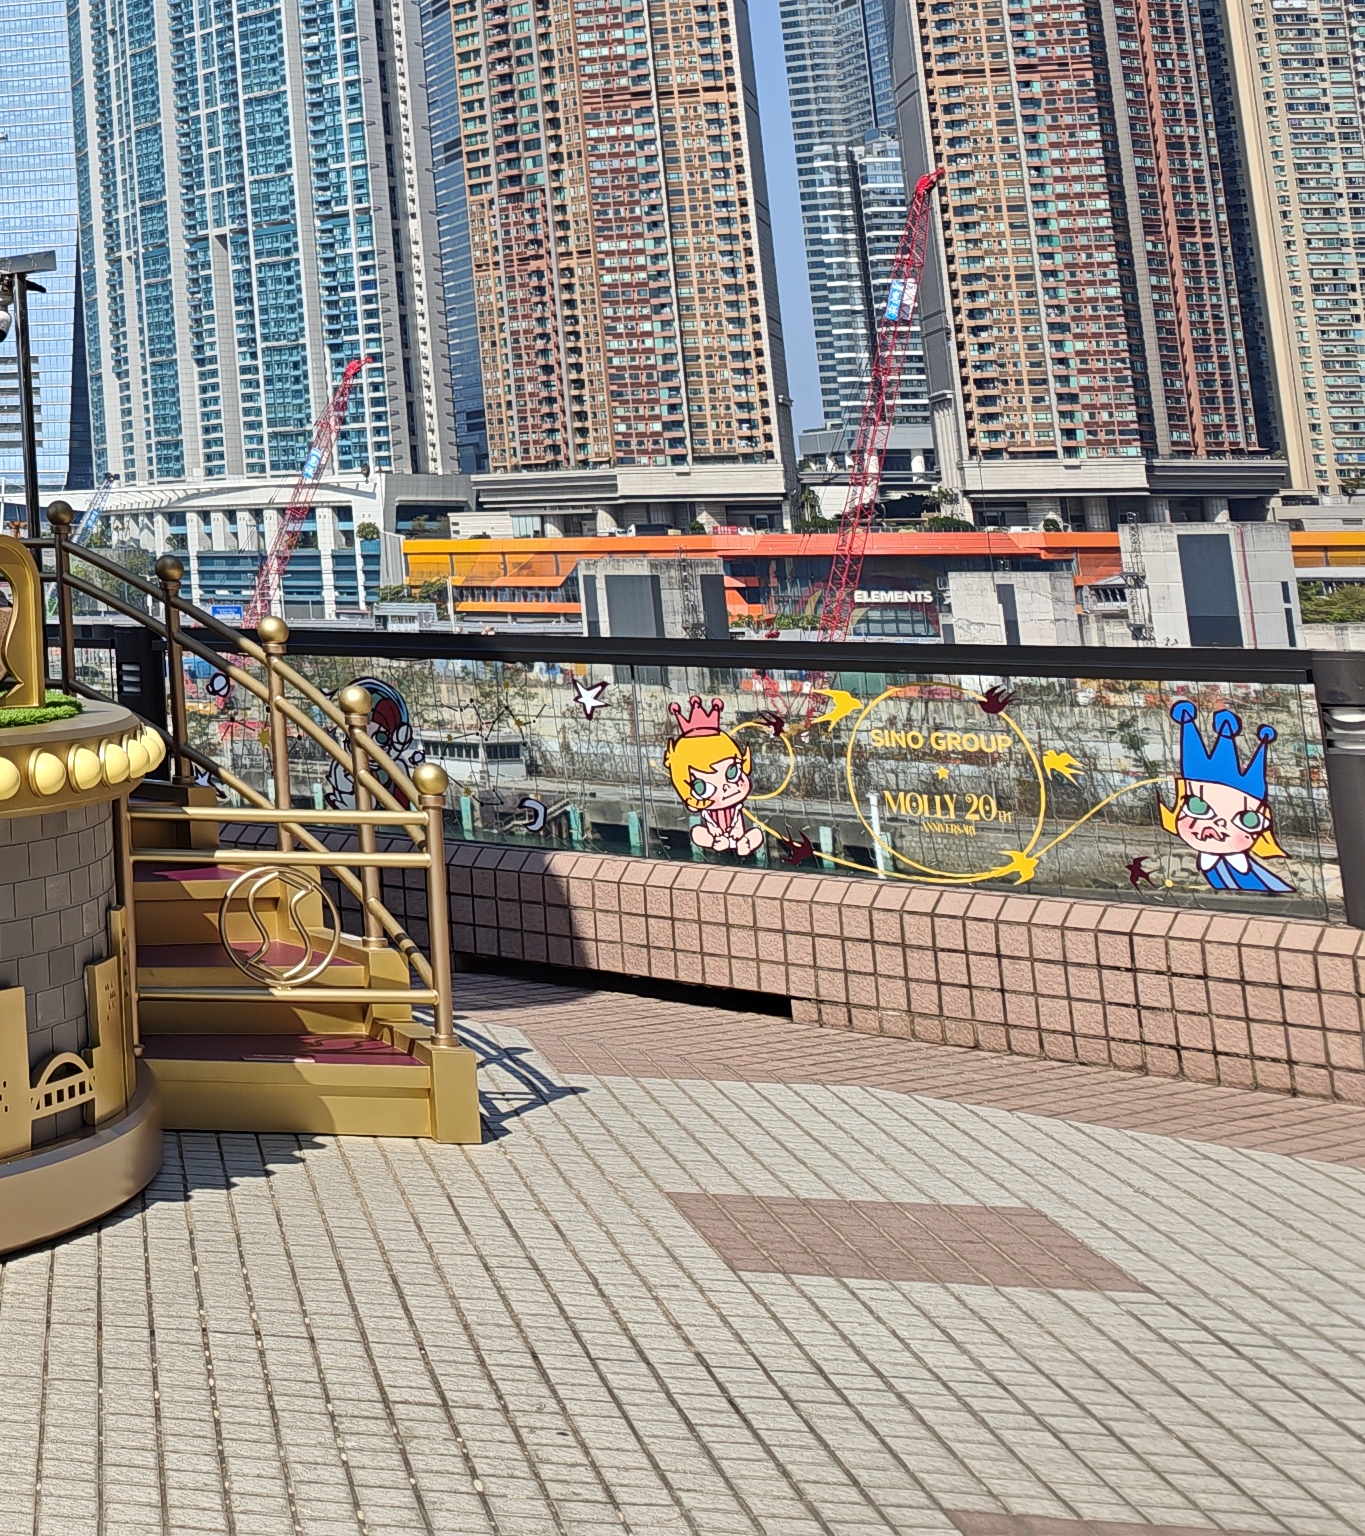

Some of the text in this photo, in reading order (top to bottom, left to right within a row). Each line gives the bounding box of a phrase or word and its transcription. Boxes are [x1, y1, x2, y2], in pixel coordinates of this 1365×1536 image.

[853, 590, 933, 603] ELEMENTS
[870, 729, 1013, 753] SINO GROUP
[883, 790, 957, 820] MOLLY
